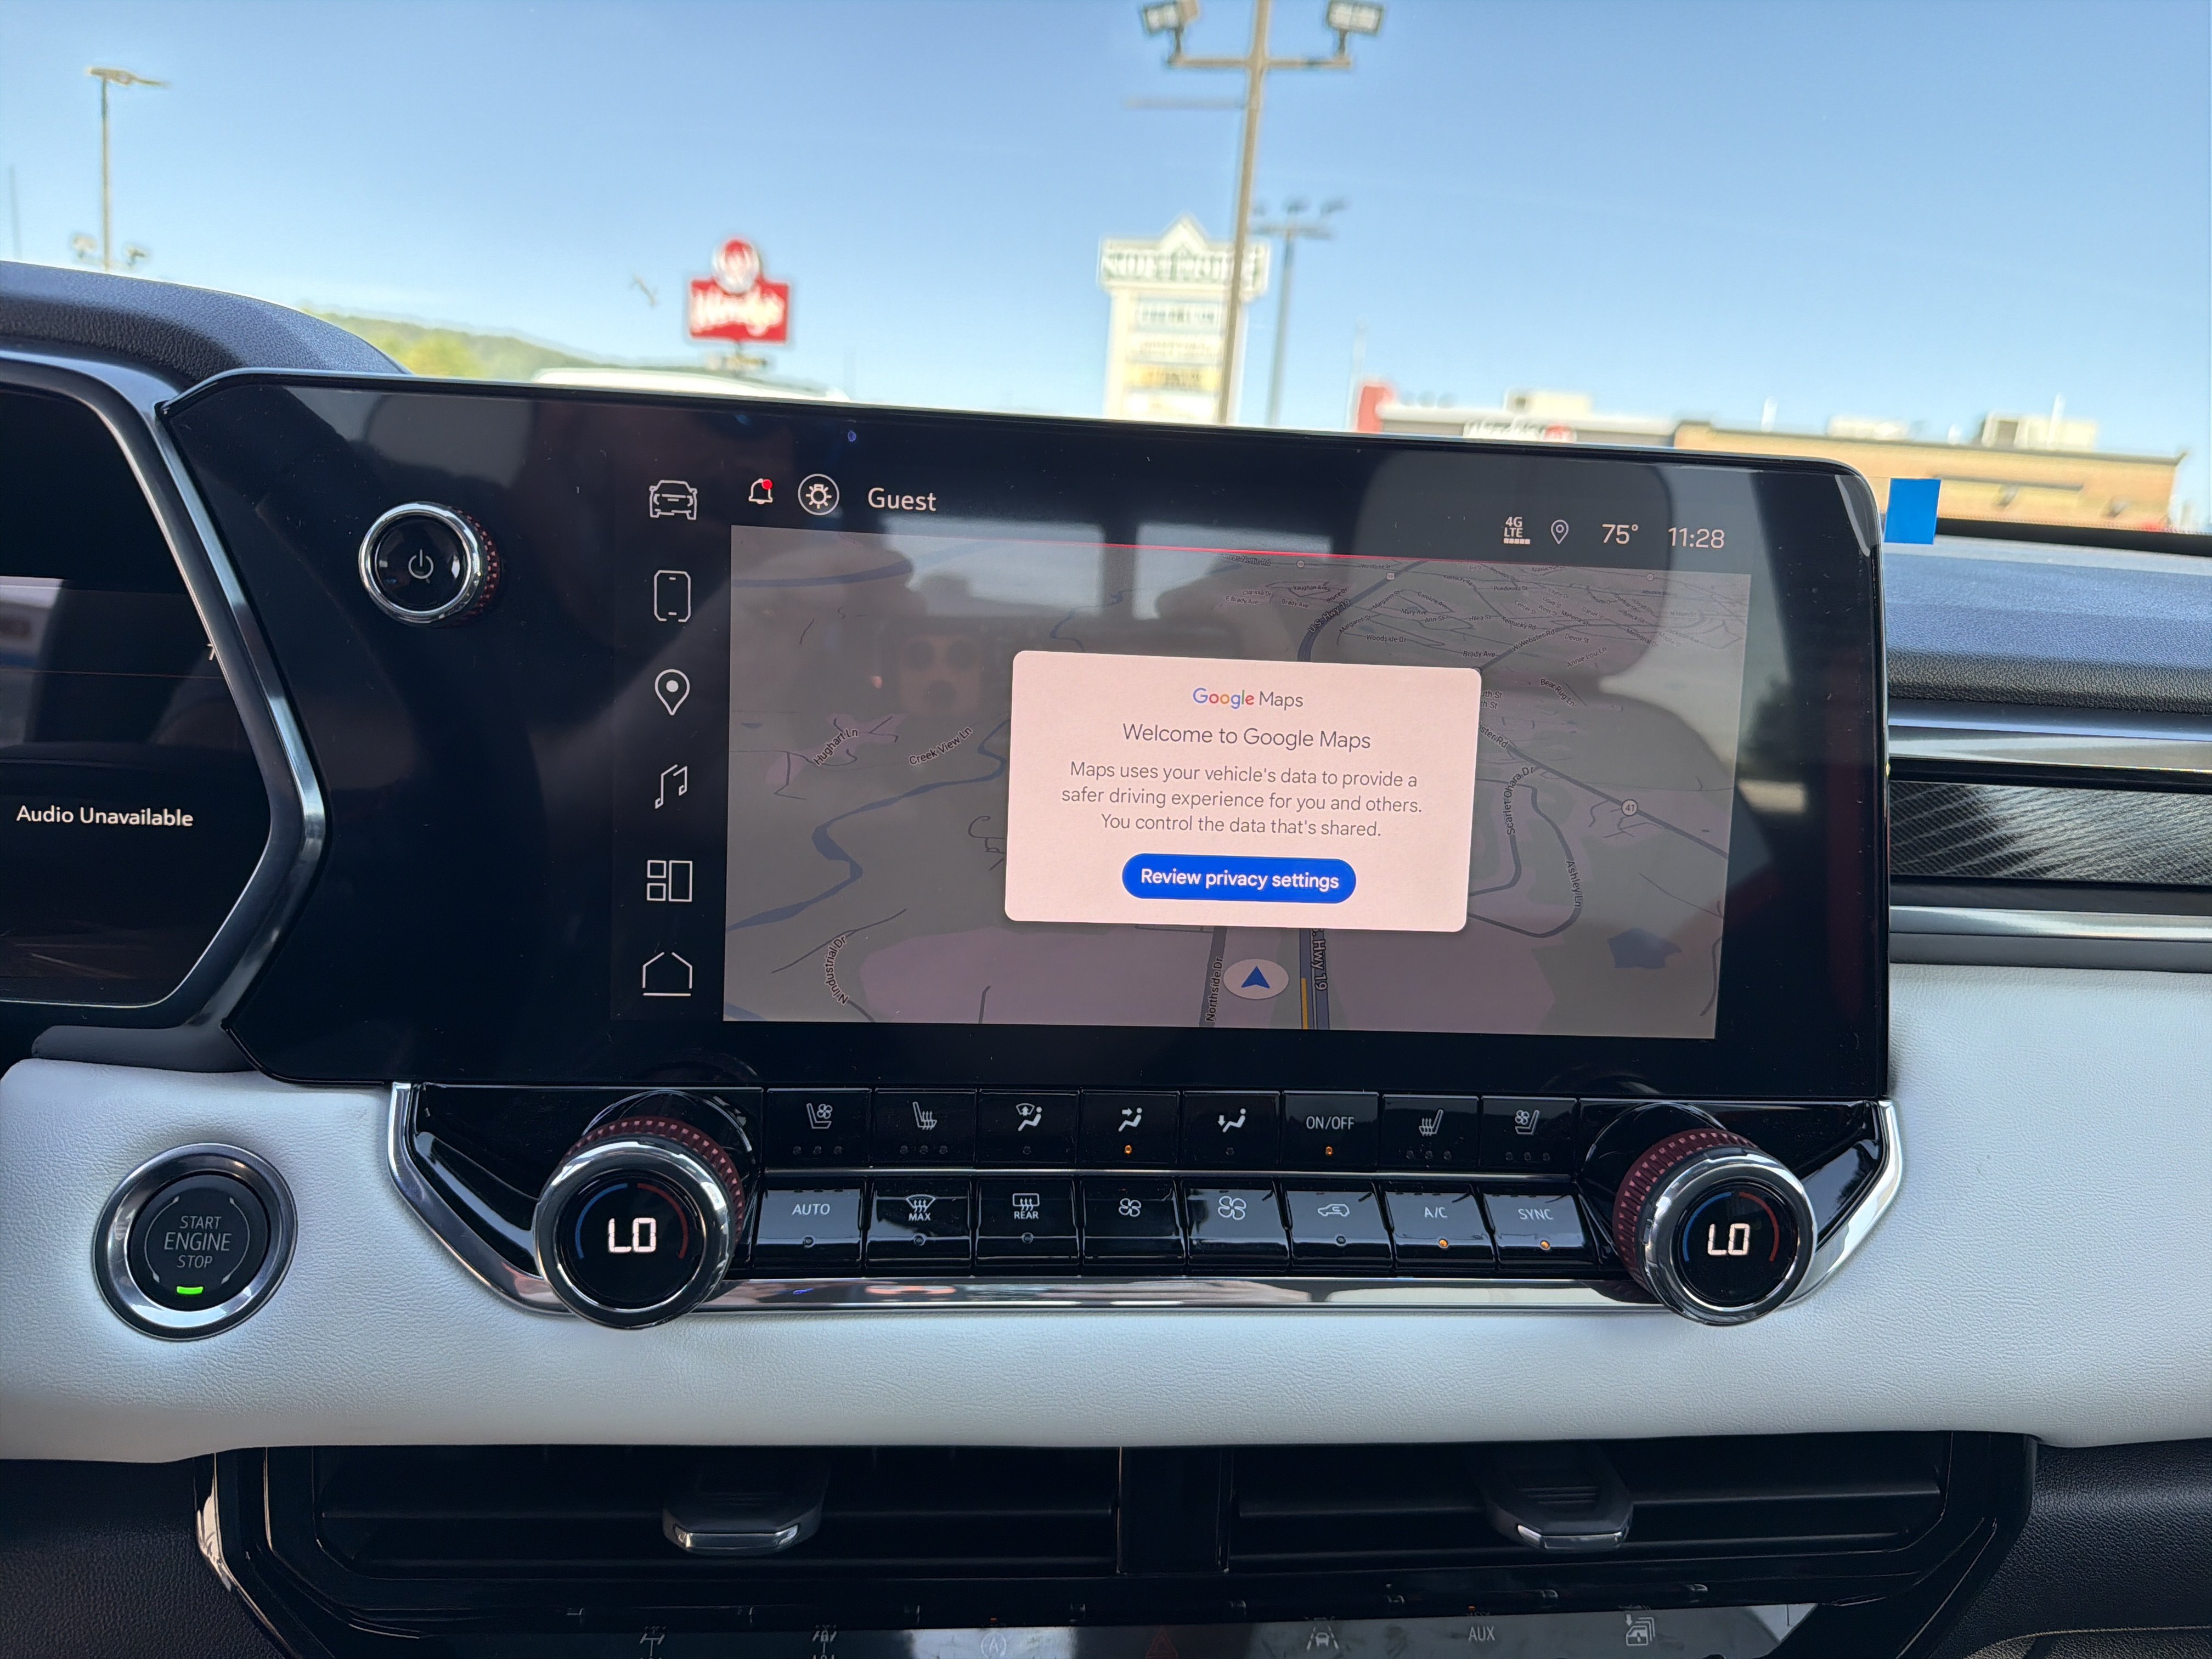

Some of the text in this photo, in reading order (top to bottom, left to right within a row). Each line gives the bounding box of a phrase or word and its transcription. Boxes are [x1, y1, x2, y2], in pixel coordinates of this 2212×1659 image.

[868, 487, 936, 511] Guest
[1505, 516, 1523, 527] 4G
[1504, 527, 1523, 538] LTE
[1601, 523, 1639, 544] 75°
[1668, 527, 1725, 549] 11:28
[1340, 587, 1348, 596] Dr
[1282, 599, 1297, 607] Brady
[1308, 599, 1351, 633] U.S. Hwy 19
[1501, 616, 1527, 629] Kentucky
[1339, 617, 1364, 634] Margaret
[1518, 633, 1545, 648] Webster
[1545, 629, 1556, 637] Rd
[1567, 657, 1585, 667] Annie
[1585, 651, 1598, 659] Lou
[1193, 687, 1304, 710] Google Maps
[1541, 678, 1576, 708] Bear Rug Ln
[1489, 701, 1498, 709] St
[909, 726, 973, 765] Creek View Ln
[1122, 723, 1371, 753] Welcome to Google Maps
[1495, 736, 1509, 748] Rd
[813, 729, 859, 766] Hughart Ln
[1070, 761, 1418, 788] Maps uses your vehicle's data to provide a
[1522, 766, 1534, 777] Dr
[1062, 786, 1422, 813] safer driving experience for you and others.
[16, 805, 194, 826] Audio Unavailable
[1101, 813, 1381, 837] You control the data that's shared.
[1141, 868, 1339, 892] Review privacy settings
[1566, 860, 1581, 908] Ashley Ln
[1312, 940, 1326, 969] Hwy
[824, 936, 849, 1005] N Industrial Dr
[1205, 956, 1224, 1022] Northside Dr
[1314, 973, 1328, 991] 19
[1306, 1115, 1355, 1131] ON/OFF
[792, 1203, 831, 1216] AUTO
[908, 1212, 932, 1222] MAX
[1013, 1211, 1040, 1221] REAR
[1423, 1206, 1448, 1220] A/C
[1517, 1208, 1554, 1222] SYNC
[179, 1216, 222, 1229] START
[164, 1232, 233, 1251] ENGINE
[177, 1255, 213, 1268] STOP
[1468, 1625, 1496, 1643] AUX
